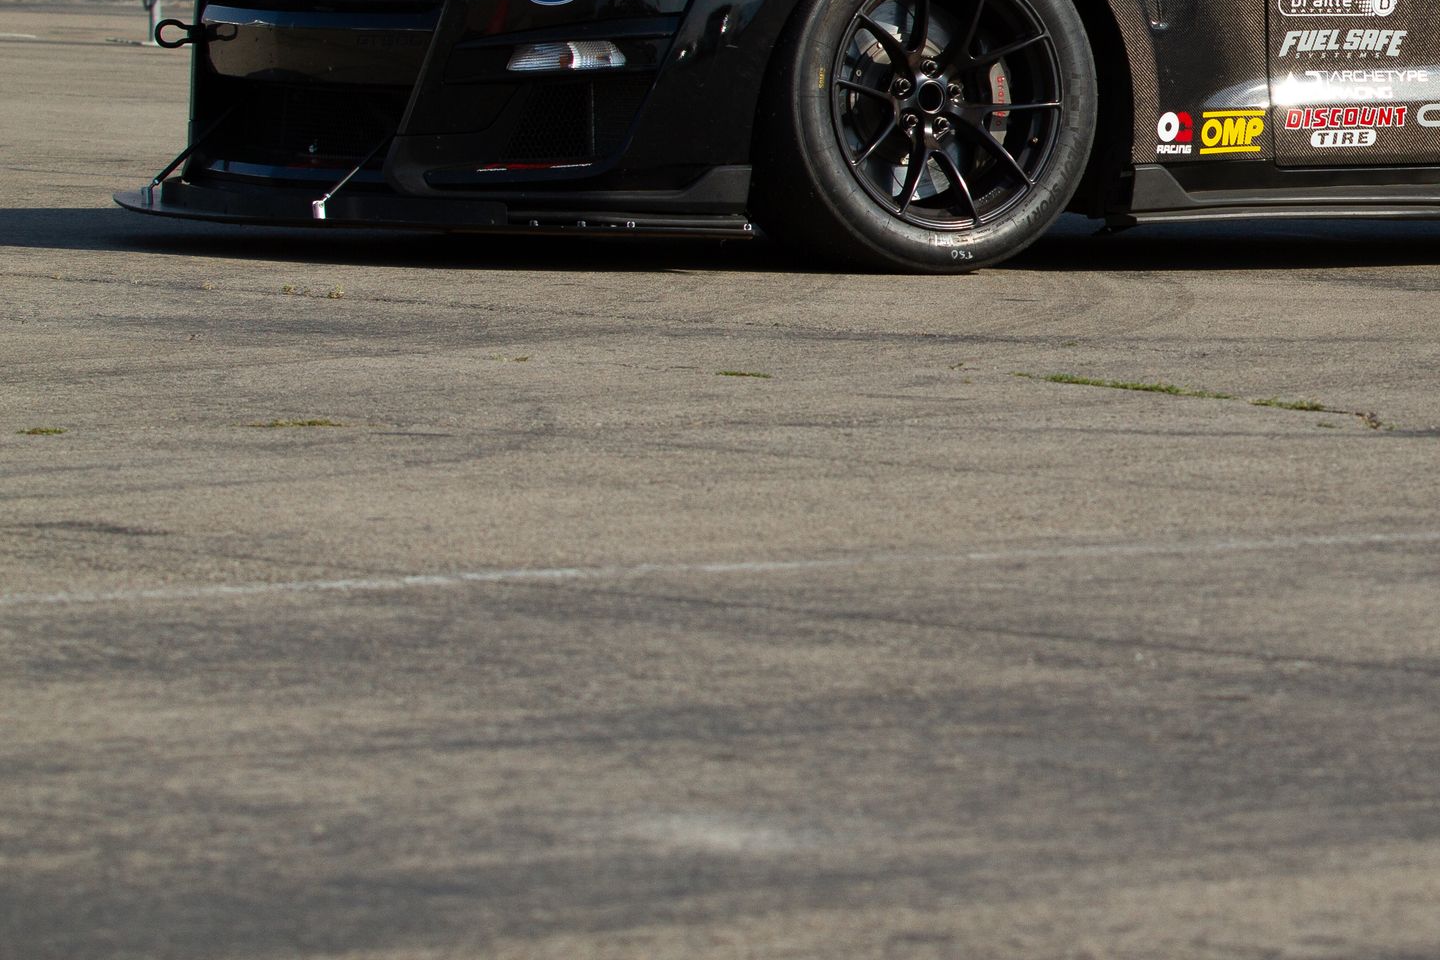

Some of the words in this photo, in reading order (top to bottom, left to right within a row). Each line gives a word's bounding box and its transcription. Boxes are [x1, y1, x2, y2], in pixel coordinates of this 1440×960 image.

[1278, 29, 1340, 57] FUEL
[1343, 29, 1408, 57] SAFE
[1329, 70, 1429, 83] ARCHETYPE
[1285, 106, 1408, 130] DISCOUNT
[1201, 117, 1265, 147] OMP
[1317, 131, 1371, 145] TIRE
[1156, 144, 1192, 154] RACING
